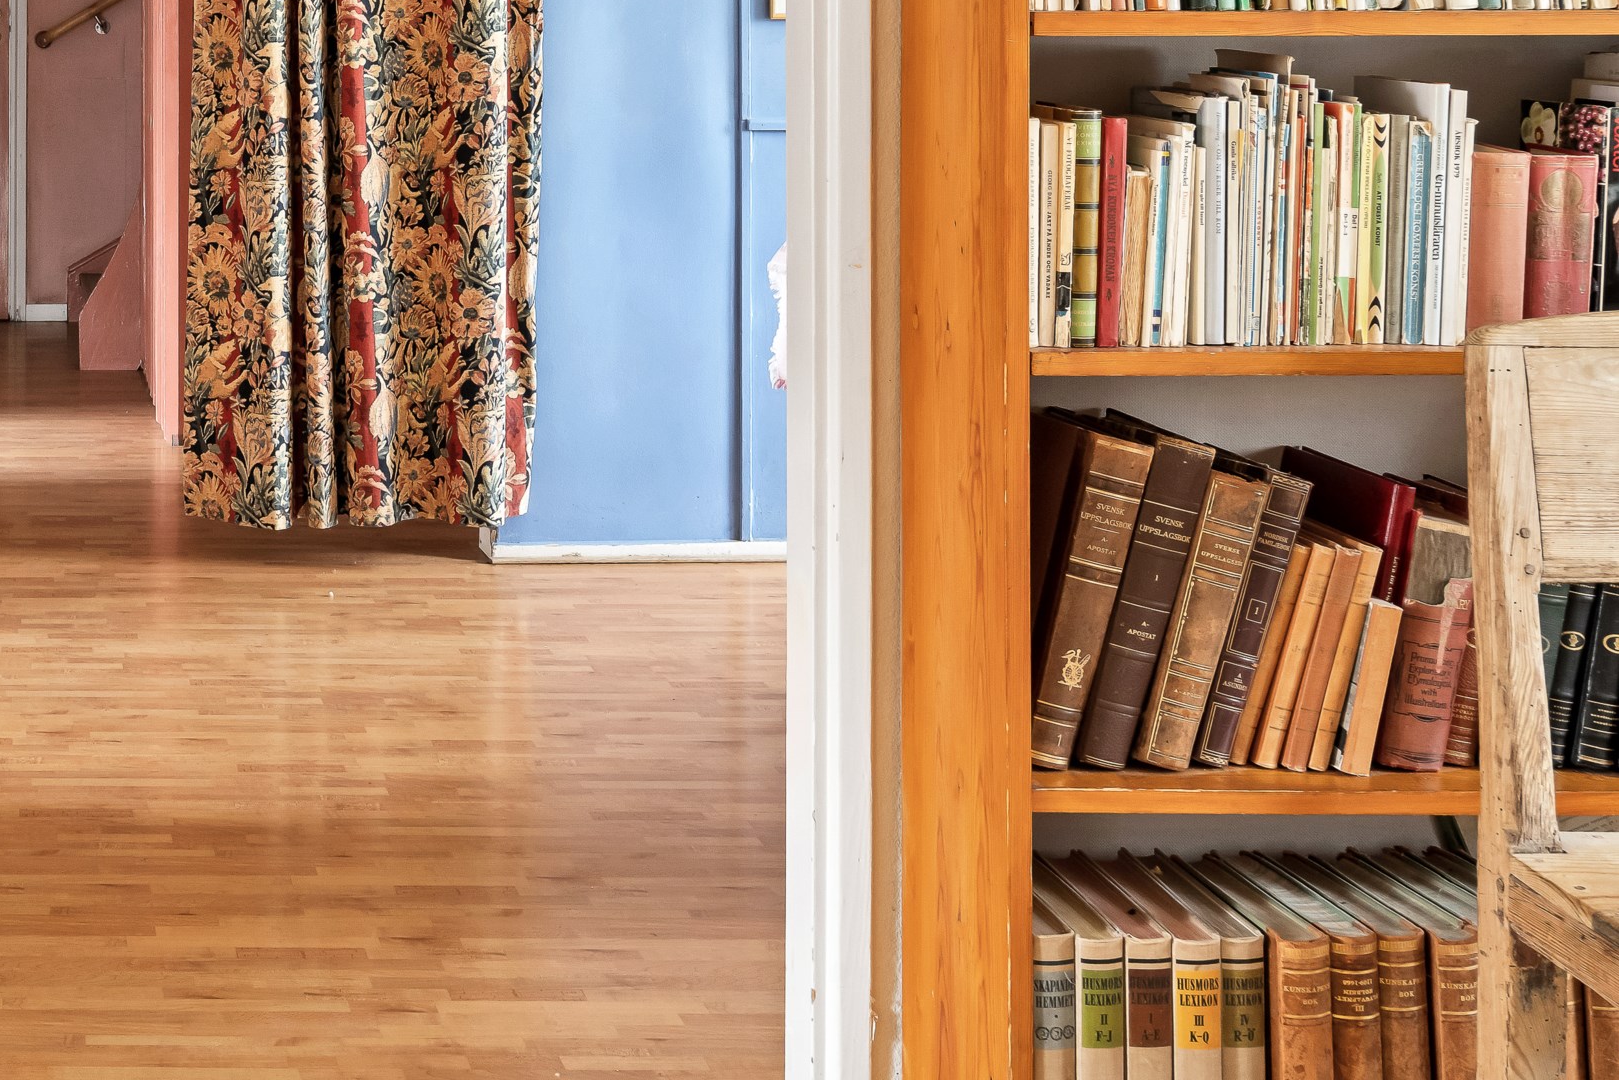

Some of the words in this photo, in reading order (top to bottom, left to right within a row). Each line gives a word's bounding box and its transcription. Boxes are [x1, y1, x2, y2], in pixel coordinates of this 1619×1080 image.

[1453, 130, 1463, 161] ÅRSBOK
[1415, 153, 1425, 193] GREKISK
[1453, 163, 1461, 179] 1979
[1064, 149, 1073, 211] FOTOGRAFERAR
[1107, 174, 1118, 193] NYA
[1413, 196, 1423, 215] OCH
[1432, 174, 1444, 261] En-minutsläraren
[1412, 219, 1422, 266] ROMERSK
[1105, 245, 1116, 282] KRONAN
[1410, 270, 1420, 302] KONST
[1096, 502, 1126, 516] SVENSK
[1080, 511, 1132, 531] UPPSLAGSBOK
[1155, 515, 1185, 528] SVENSK
[1139, 524, 1192, 544] UPPSLAGSBOK
[1263, 531, 1289, 544] NORDISK
[1086, 544, 1117, 555] APOSTAT
[1214, 543, 1241, 555] SVENSK
[1126, 628, 1157, 640] APOSTAT
[1421, 688, 1438, 697] with
[1057, 733, 1063, 747] 1
[1082, 975, 1123, 991] HUSMORS
[1129, 975, 1171, 990] HUSMORS
[1176, 977, 1220, 991] HUSMORS
[1222, 976, 1264, 991] HUSMORS
[1035, 994, 1075, 1009] HEMMET
[1084, 992, 1122, 1007] LEXIKON
[1131, 992, 1170, 1006] LEXIKON
[1179, 993, 1219, 1007] LEXIKON
[1224, 992, 1263, 1007] LEXIKON
[1398, 990, 1415, 998] BOK
[1460, 994, 1477, 1002] BOK
[1302, 998, 1319, 1006] BOK
[1100, 1013, 1109, 1026] II
[1193, 1014, 1205, 1027] III
[1095, 1030, 1113, 1043] F-J
[1142, 1029, 1161, 1042] A-E
[1189, 1030, 1210, 1045] K-Q
[1233, 1027, 1256, 1043] R-Ö
